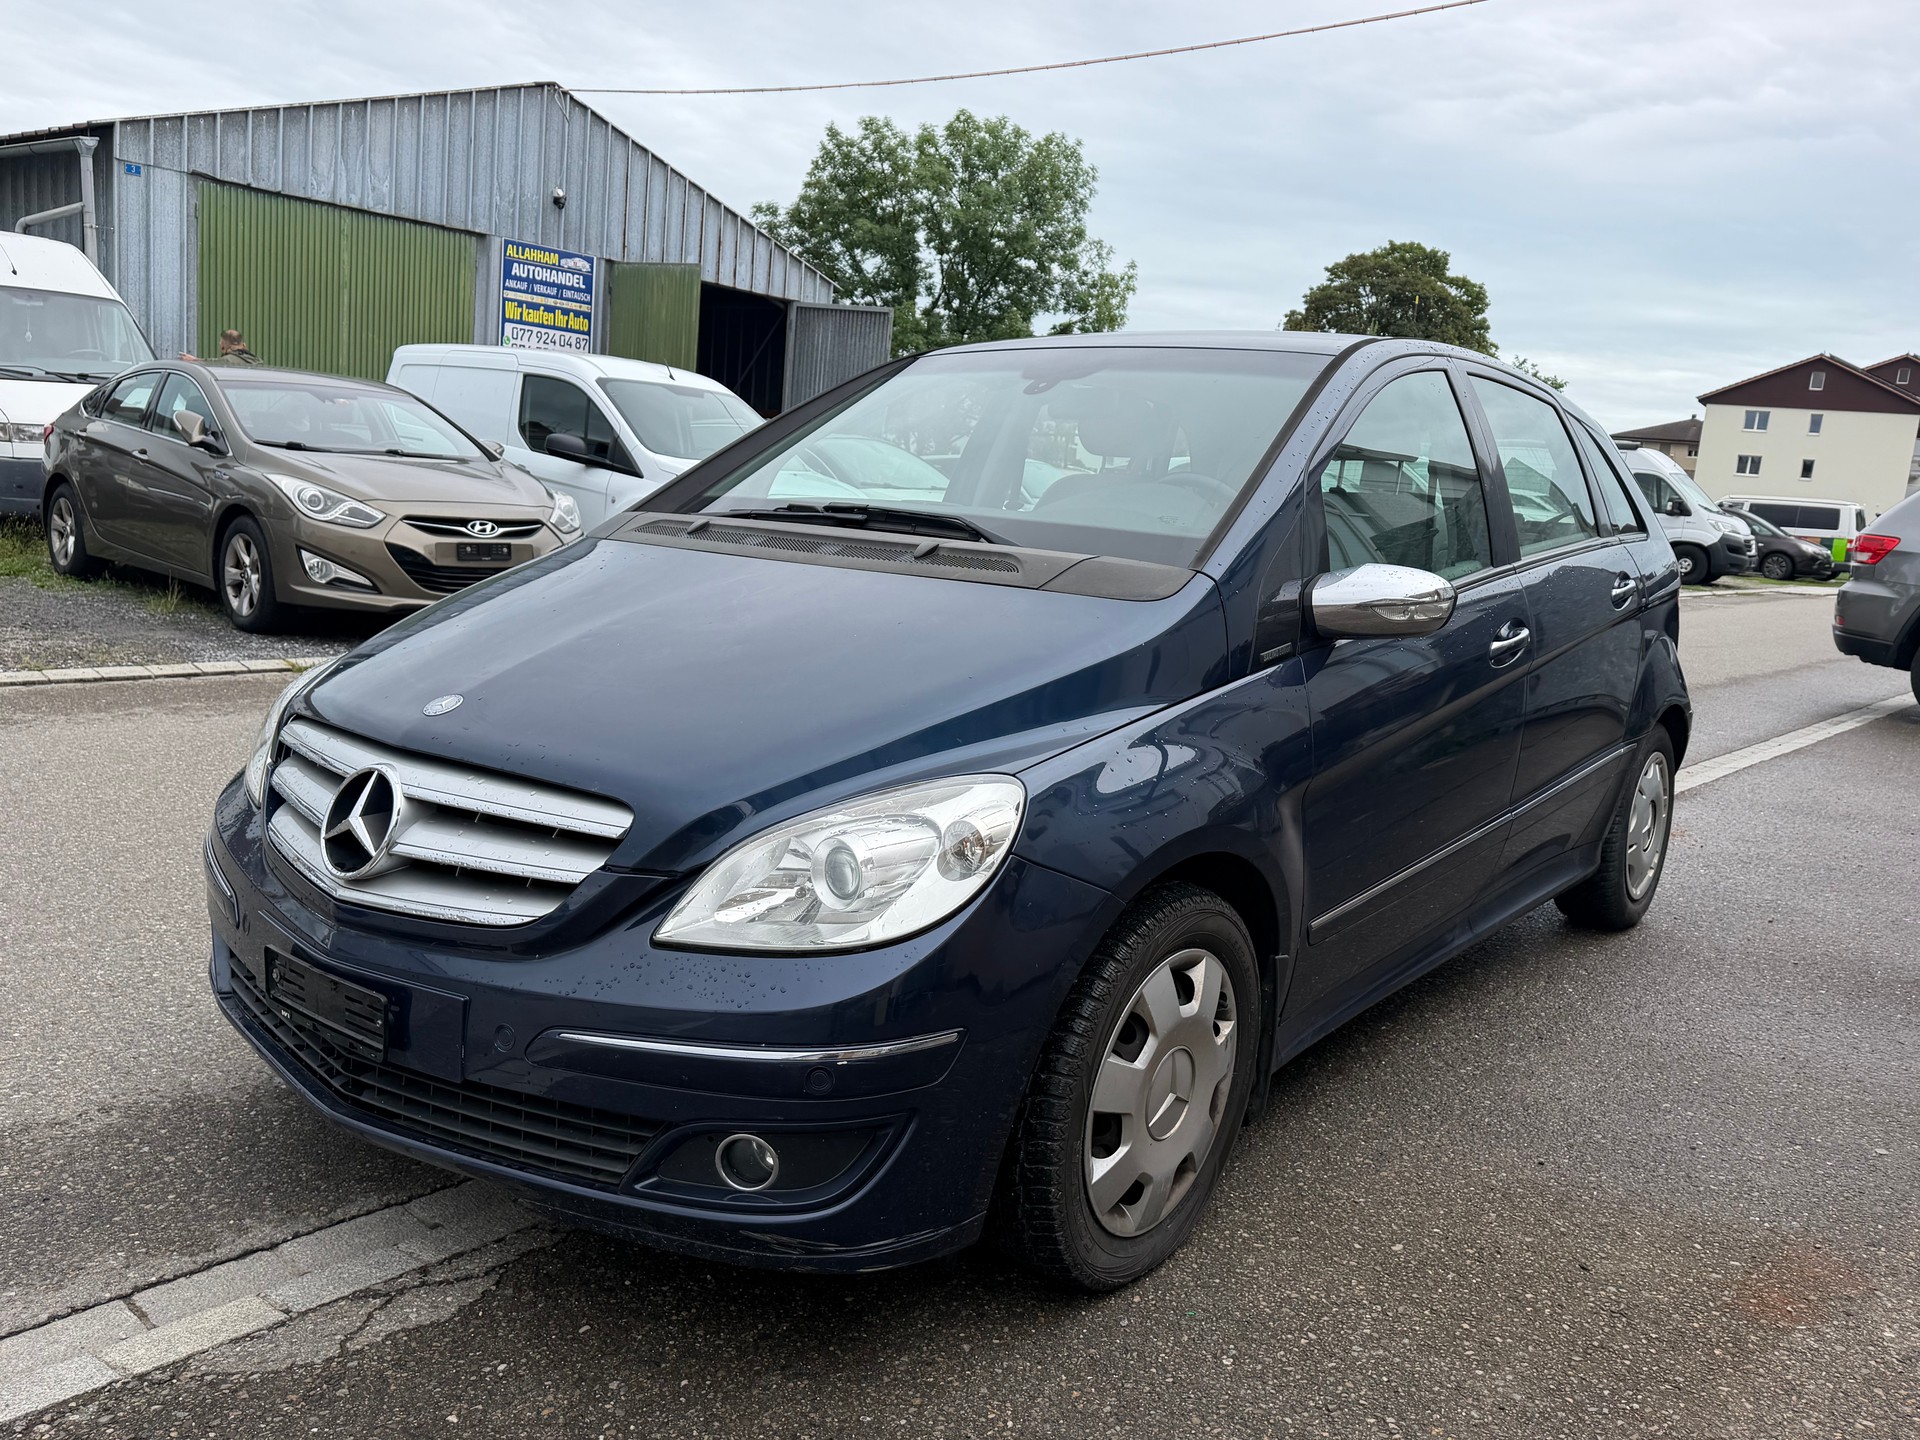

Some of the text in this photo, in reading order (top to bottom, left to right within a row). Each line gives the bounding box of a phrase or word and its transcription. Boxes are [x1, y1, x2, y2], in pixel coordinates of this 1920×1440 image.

[131, 165, 136, 173] 3
[506, 244, 559, 266] ALLAHHAM
[511, 262, 586, 289] AUTOHANDEL
[505, 279, 528, 290] ANKAUF
[533, 284, 558, 296] VERKAUF
[562, 289, 591, 302] EINTAUSCH
[505, 300, 589, 332] Wir kaufen Ihr Auto
[511, 326, 534, 343] 077
[535, 330, 557, 347] 924
[559, 334, 573, 349] 04
[574, 337, 588, 351] 87
